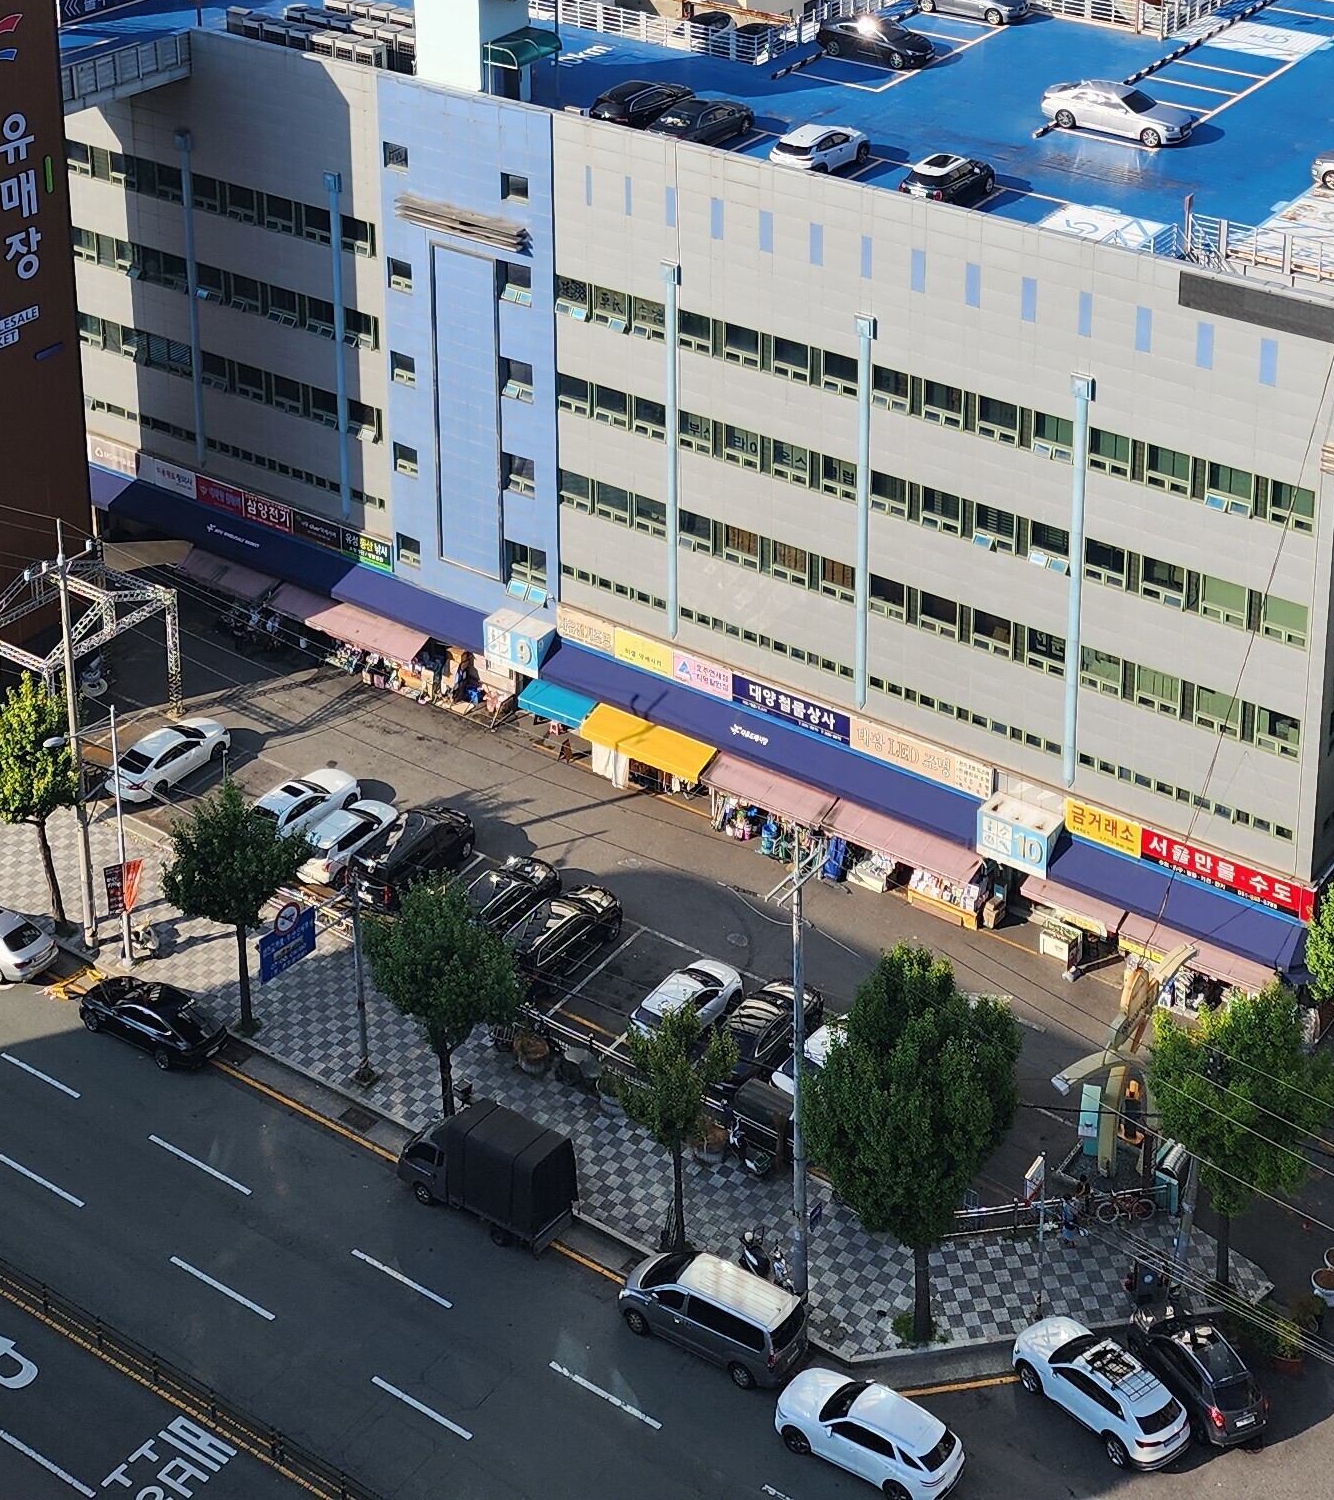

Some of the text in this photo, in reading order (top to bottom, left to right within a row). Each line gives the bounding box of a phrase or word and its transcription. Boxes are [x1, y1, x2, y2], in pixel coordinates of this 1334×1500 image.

[245, 499, 292, 528] 삼양전기
[749, 684, 836, 731] 대양철물상사
[887, 737, 920, 765] LED
[922, 752, 952, 778] 조명
[1071, 807, 1135, 844] 금거래소
[1013, 832, 1043, 864] 10
[1249, 874, 1293, 903] 수도
